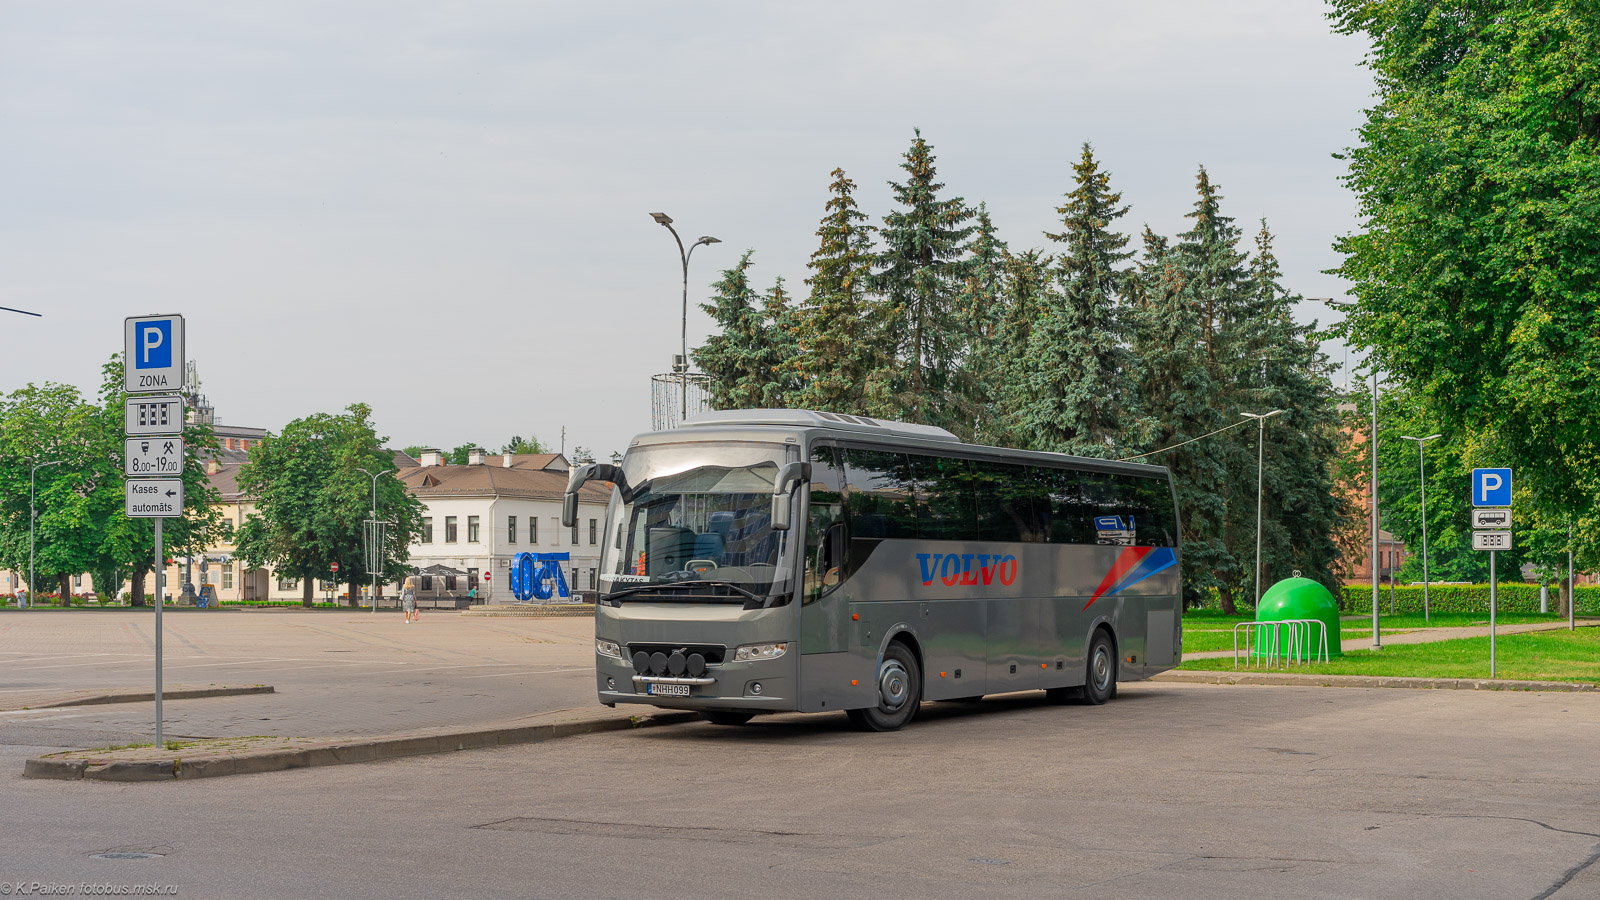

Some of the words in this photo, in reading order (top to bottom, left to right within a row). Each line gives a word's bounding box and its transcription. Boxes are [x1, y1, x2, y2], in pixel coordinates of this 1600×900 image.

[144, 327, 163, 362] P
[139, 375, 168, 387] ZONA
[132, 456, 178, 472] 8.00-19.00
[132, 484, 158, 494] Kases
[1482, 473, 1503, 501] P
[132, 502, 173, 513] automāts
[916, 553, 1018, 587] VOLVO
[656, 684, 689, 695] NHH099
